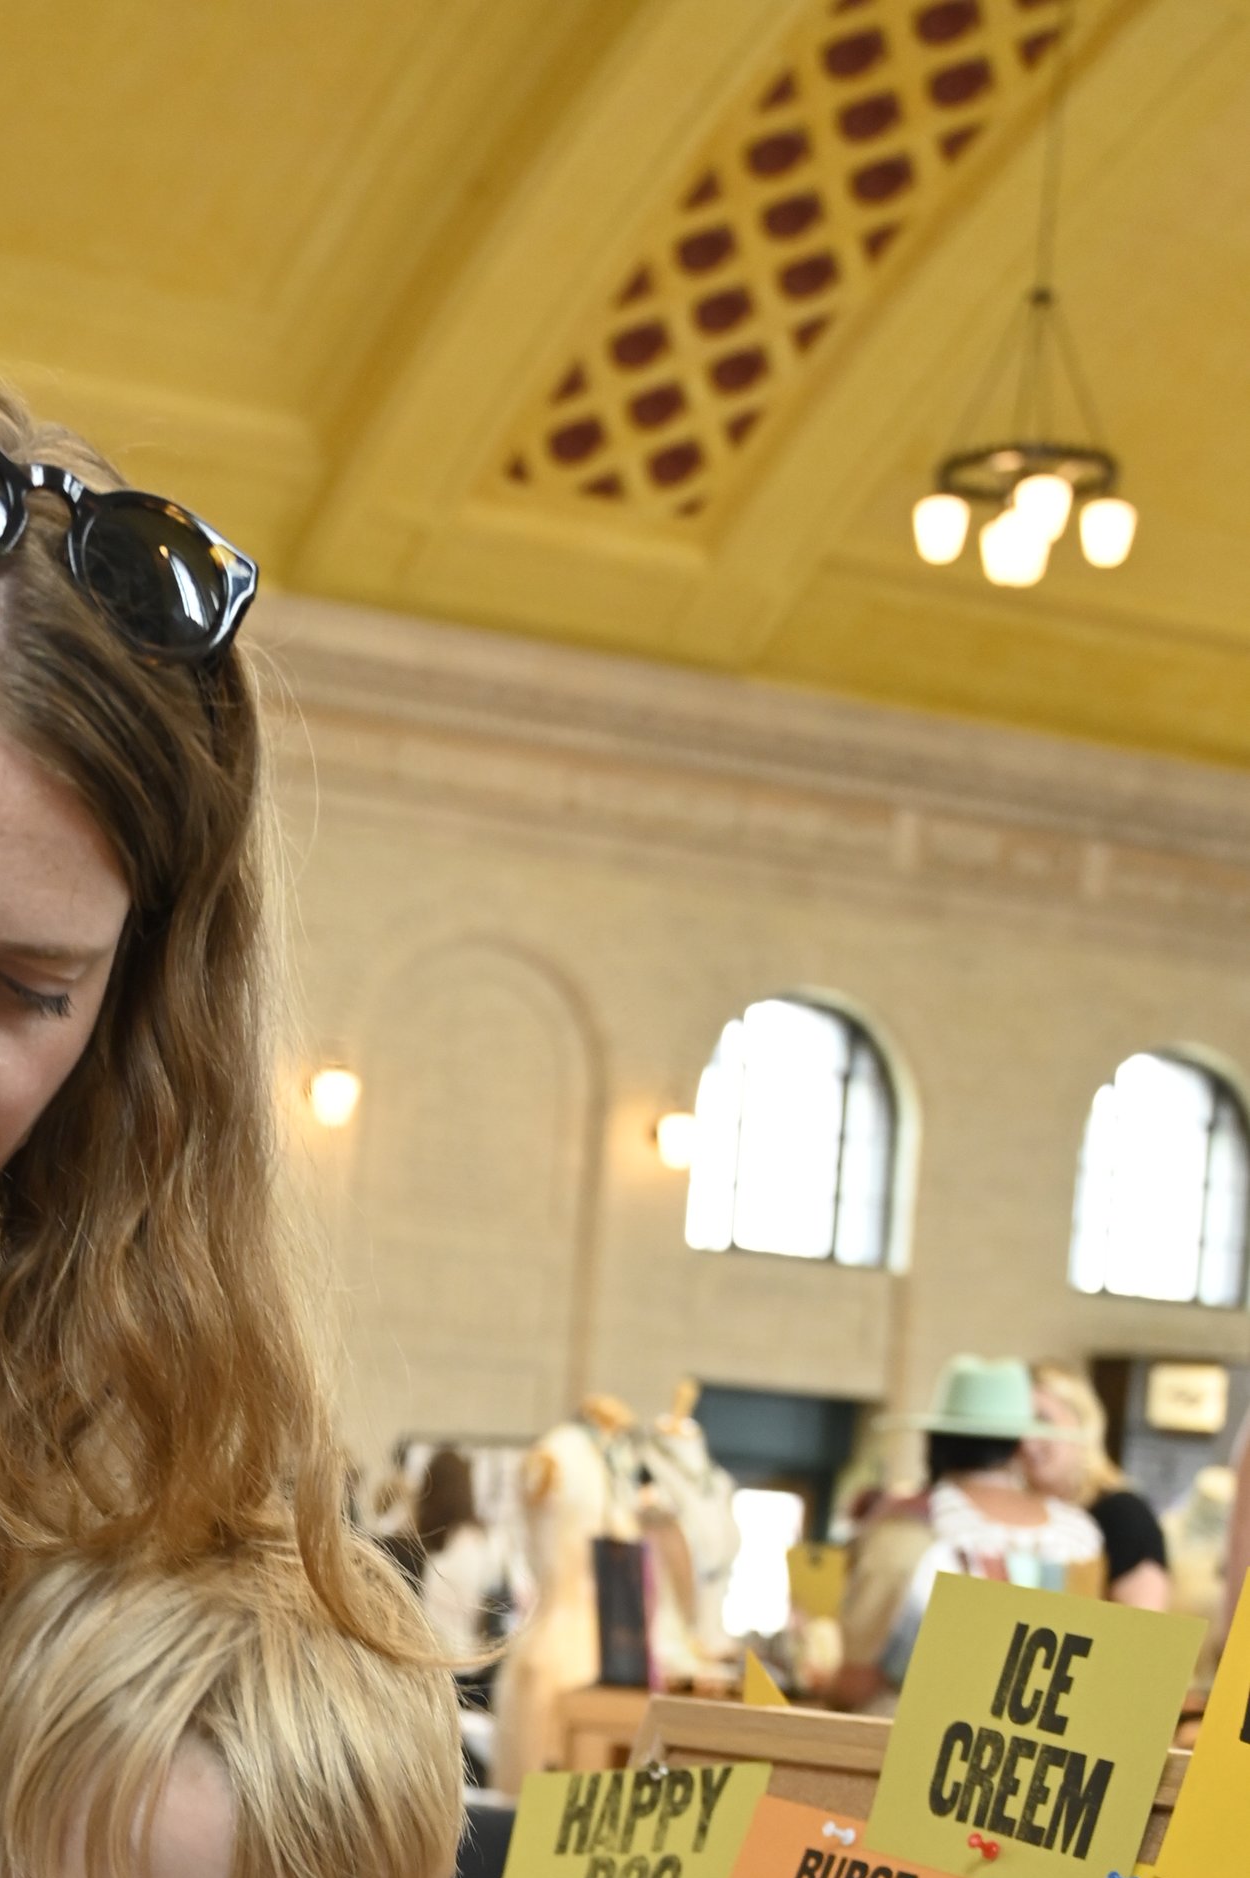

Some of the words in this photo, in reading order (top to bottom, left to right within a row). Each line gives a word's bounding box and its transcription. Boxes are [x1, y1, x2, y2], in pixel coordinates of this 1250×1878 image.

[990, 1621, 1093, 1735] ICE
[555, 1767, 732, 1855] HAPPY
[928, 1721, 1114, 1860] CREEM
